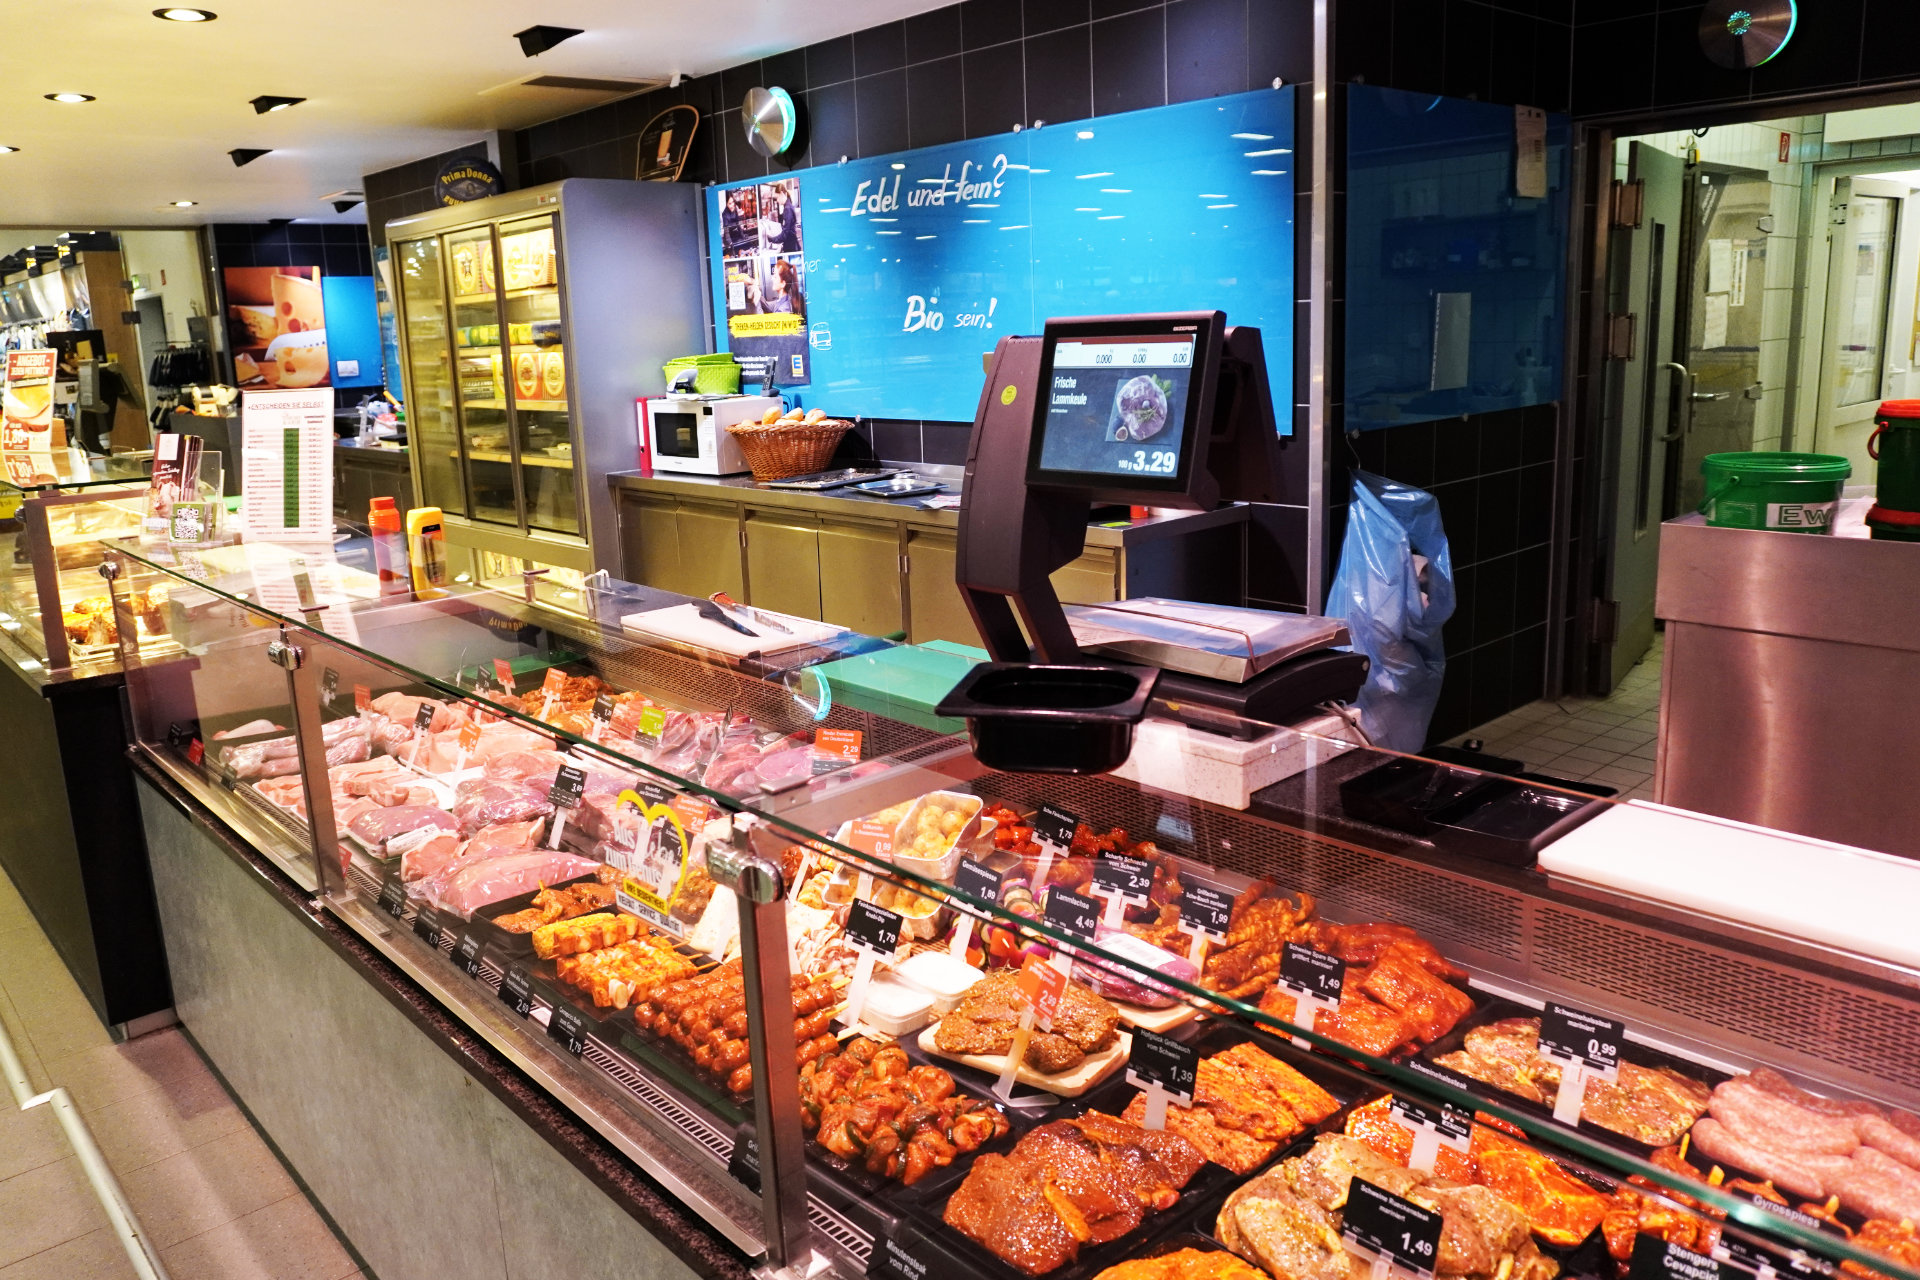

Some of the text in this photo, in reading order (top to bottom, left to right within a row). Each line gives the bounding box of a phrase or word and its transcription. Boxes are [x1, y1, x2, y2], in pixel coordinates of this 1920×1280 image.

[441, 168, 493, 184] Prima Donna
[851, 153, 1008, 217] Edel und fein?
[902, 295, 998, 332] Bio sein!
[1096, 354, 1112, 364] 0.000
[1132, 354, 1146, 364] 0.00
[1173, 353, 1187, 363] 0.00
[1054, 376, 1077, 389] Frische
[1052, 393, 1087, 405] Lammkeule
[1133, 450, 1176, 473] 3.29
[843, 745, 858, 754] 2.29
[1058, 827, 1073, 840] 1.79
[875, 841, 892, 853] 0.99
[1123, 856, 1148, 867] Schnecke
[1128, 875, 1150, 889] 2.39
[1056, 892, 1090, 910] Lammlachse
[1075, 915, 1095, 928] 4.49
[1211, 911, 1229, 924] 1.99
[878, 929, 896, 943] 1.79
[1318, 974, 1340, 989] 1.49
[1554, 1006, 1612, 1030] Schweinehalssteak
[569, 1038, 582, 1053] 1.79
[1146, 1043, 1181, 1060] vom Schwein
[1587, 1039, 1616, 1056] 0.99
[1170, 1065, 1193, 1083] 1.39
[1410, 1060, 1468, 1091] Schweinehalssteak
[1360, 1184, 1388, 1202] Schweine
[1752, 1194, 1820, 1229] Gyrosspiess
[1401, 1232, 1433, 1256] 1.49
[886, 1239, 927, 1276] Minutensteak
[1667, 1243, 1719, 1271] Stengers
[889, 1257, 919, 1280] vom Rind
[1663, 1255, 1720, 1280] Cevapcici
